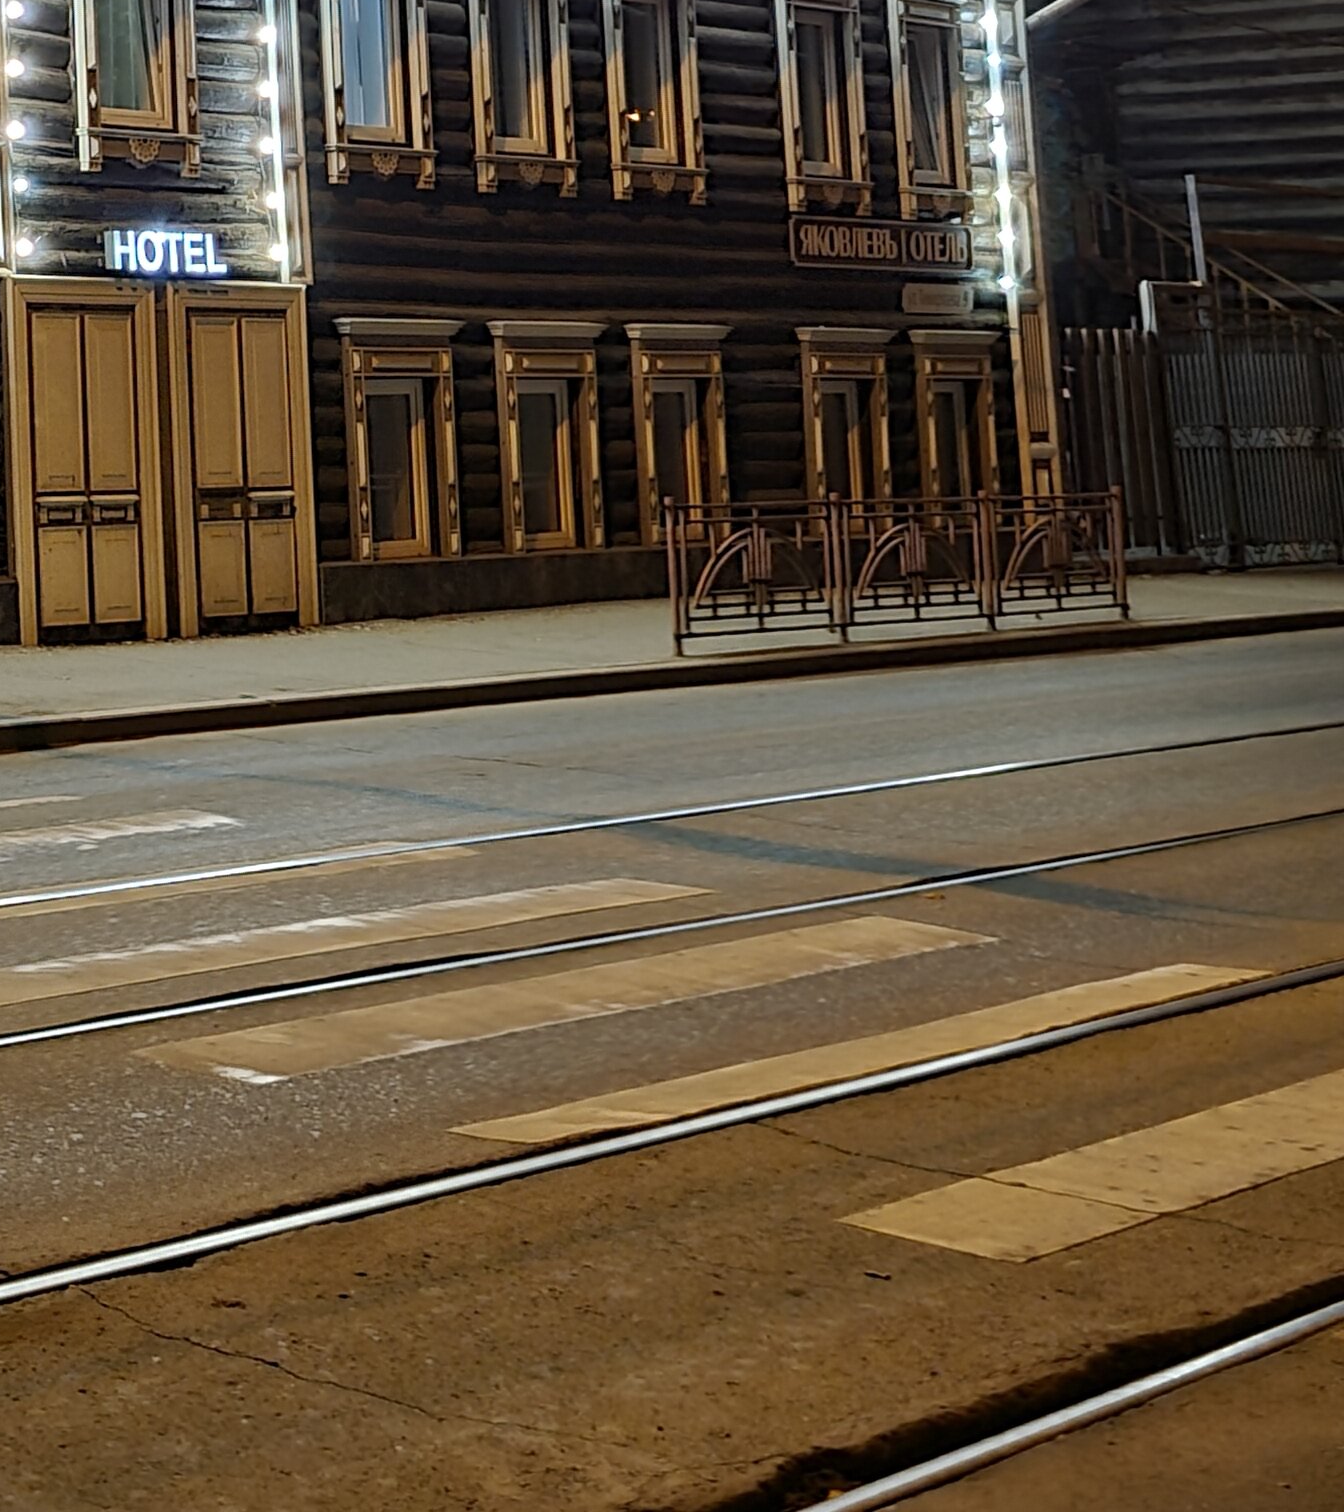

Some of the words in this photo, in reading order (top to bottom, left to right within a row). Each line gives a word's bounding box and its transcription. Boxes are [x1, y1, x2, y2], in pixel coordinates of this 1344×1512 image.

[104, 230, 228, 274] HOTEL
[800, 224, 898, 260] ЯКОВЛЕВЪ
[911, 231, 968, 263] ОТЕЛЬ
